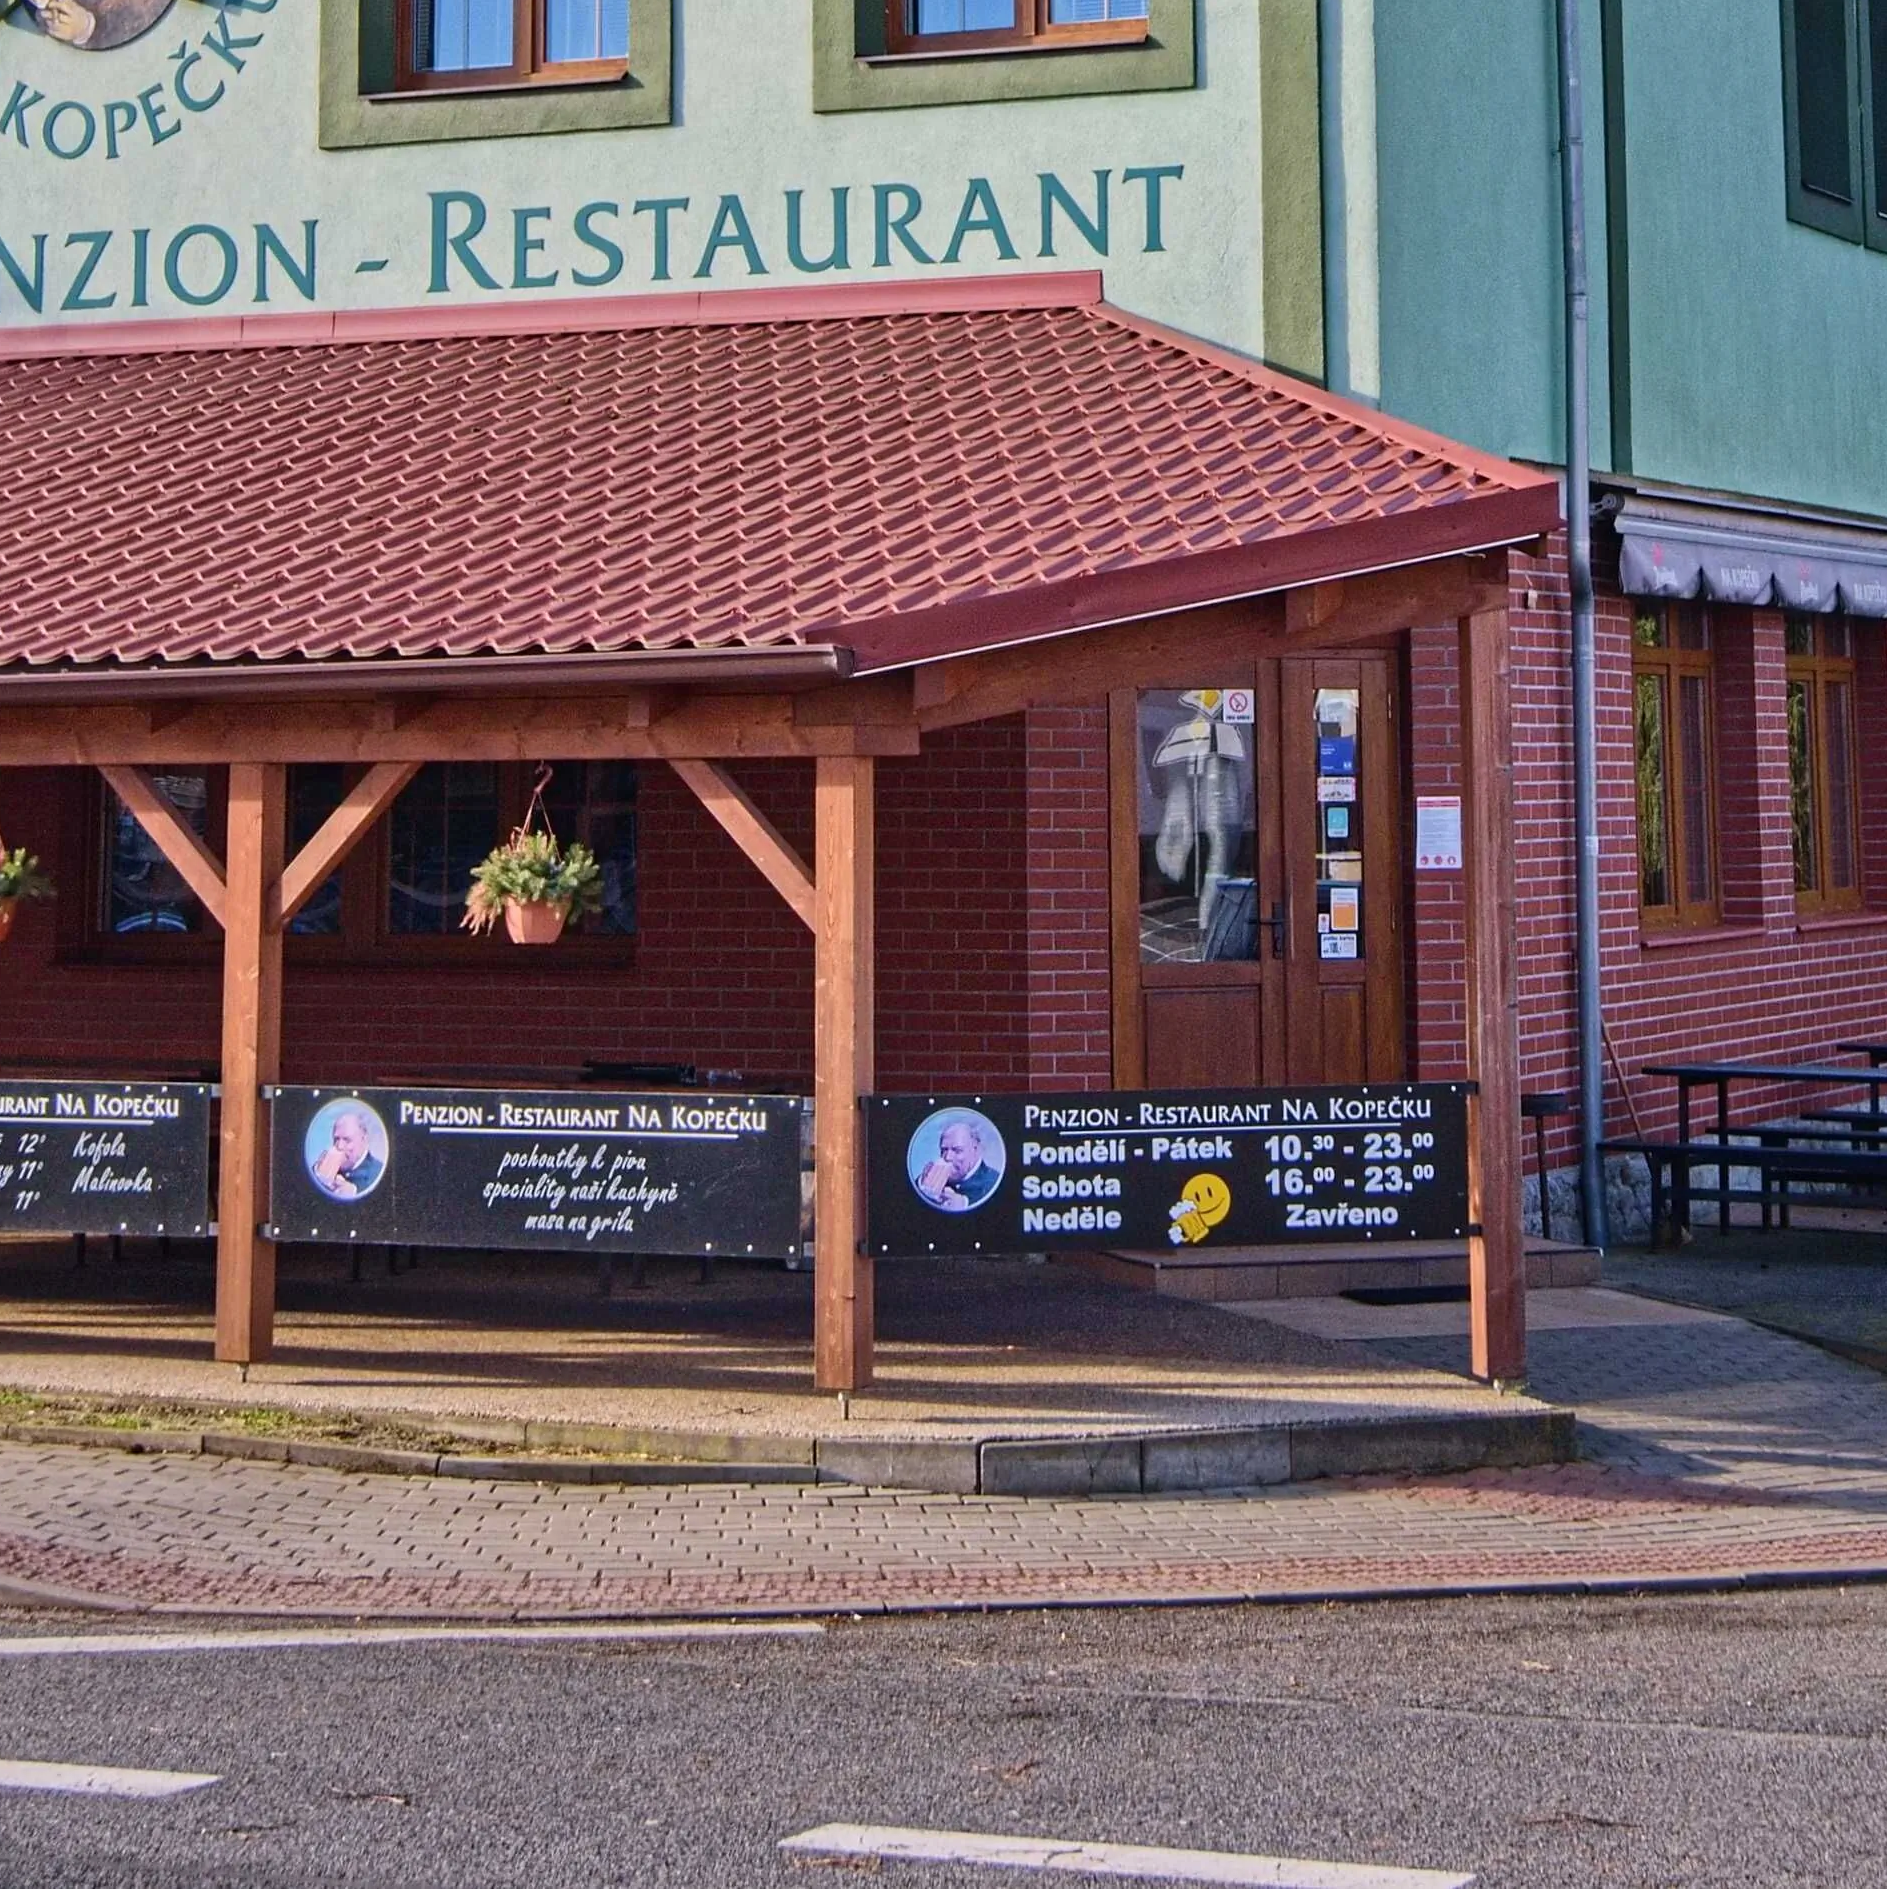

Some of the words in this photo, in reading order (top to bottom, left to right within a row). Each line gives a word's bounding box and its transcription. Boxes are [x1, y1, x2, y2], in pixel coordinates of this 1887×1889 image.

[425, 163, 1185, 293] RESTAURANT
[55, 1093, 85, 1115] NA
[93, 1093, 179, 1118] KOPEČKU
[400, 1101, 483, 1126] PENZION
[499, 1102, 619, 1128] RESTAURANT
[628, 1104, 662, 1128] NA
[671, 1105, 767, 1131] KOPEČKU
[1024, 1104, 1119, 1128] PENZION
[1139, 1102, 1271, 1126] RESTAURANT
[1281, 1099, 1318, 1121] NA
[1329, 1095, 1431, 1120] KOPEČKU
[72, 1130, 126, 1164] Kofola
[497, 1143, 589, 1179] pochoutky
[591, 1143, 607, 1169] k
[609, 1149, 646, 1175] pivu
[1022, 1139, 1126, 1166] Pondělí
[1151, 1136, 1233, 1162] Pátek
[71, 1165, 152, 1194] Malinovka
[482, 1170, 566, 1210] speciality
[569, 1177, 605, 1201] naší
[605, 1176, 679, 1212] kuchyně
[1022, 1174, 1122, 1199] Sobota
[524, 1211, 565, 1230] masa
[568, 1217, 587, 1231] na
[587, 1205, 634, 1242] grilu
[1022, 1206, 1123, 1232] Neděle
[1286, 1202, 1399, 1228] Zavřeno
